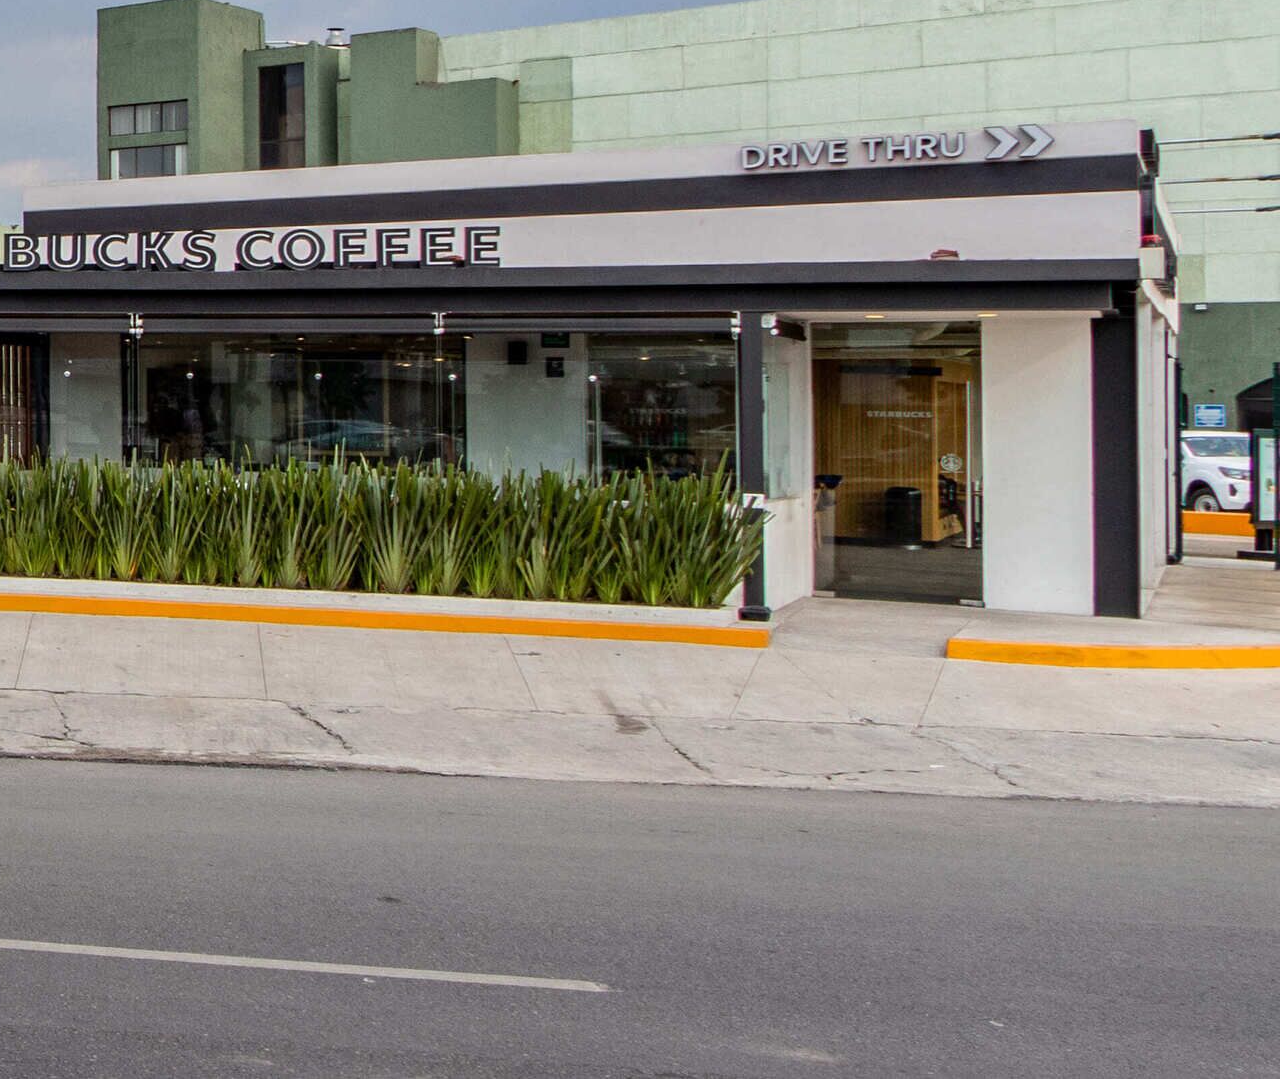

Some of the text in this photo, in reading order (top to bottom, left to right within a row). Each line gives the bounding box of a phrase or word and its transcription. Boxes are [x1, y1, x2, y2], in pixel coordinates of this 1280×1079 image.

[741, 132, 966, 170] DRIVE THRU
[235, 225, 502, 271] COFFEE
[866, 410, 934, 419] STARBUCKS
